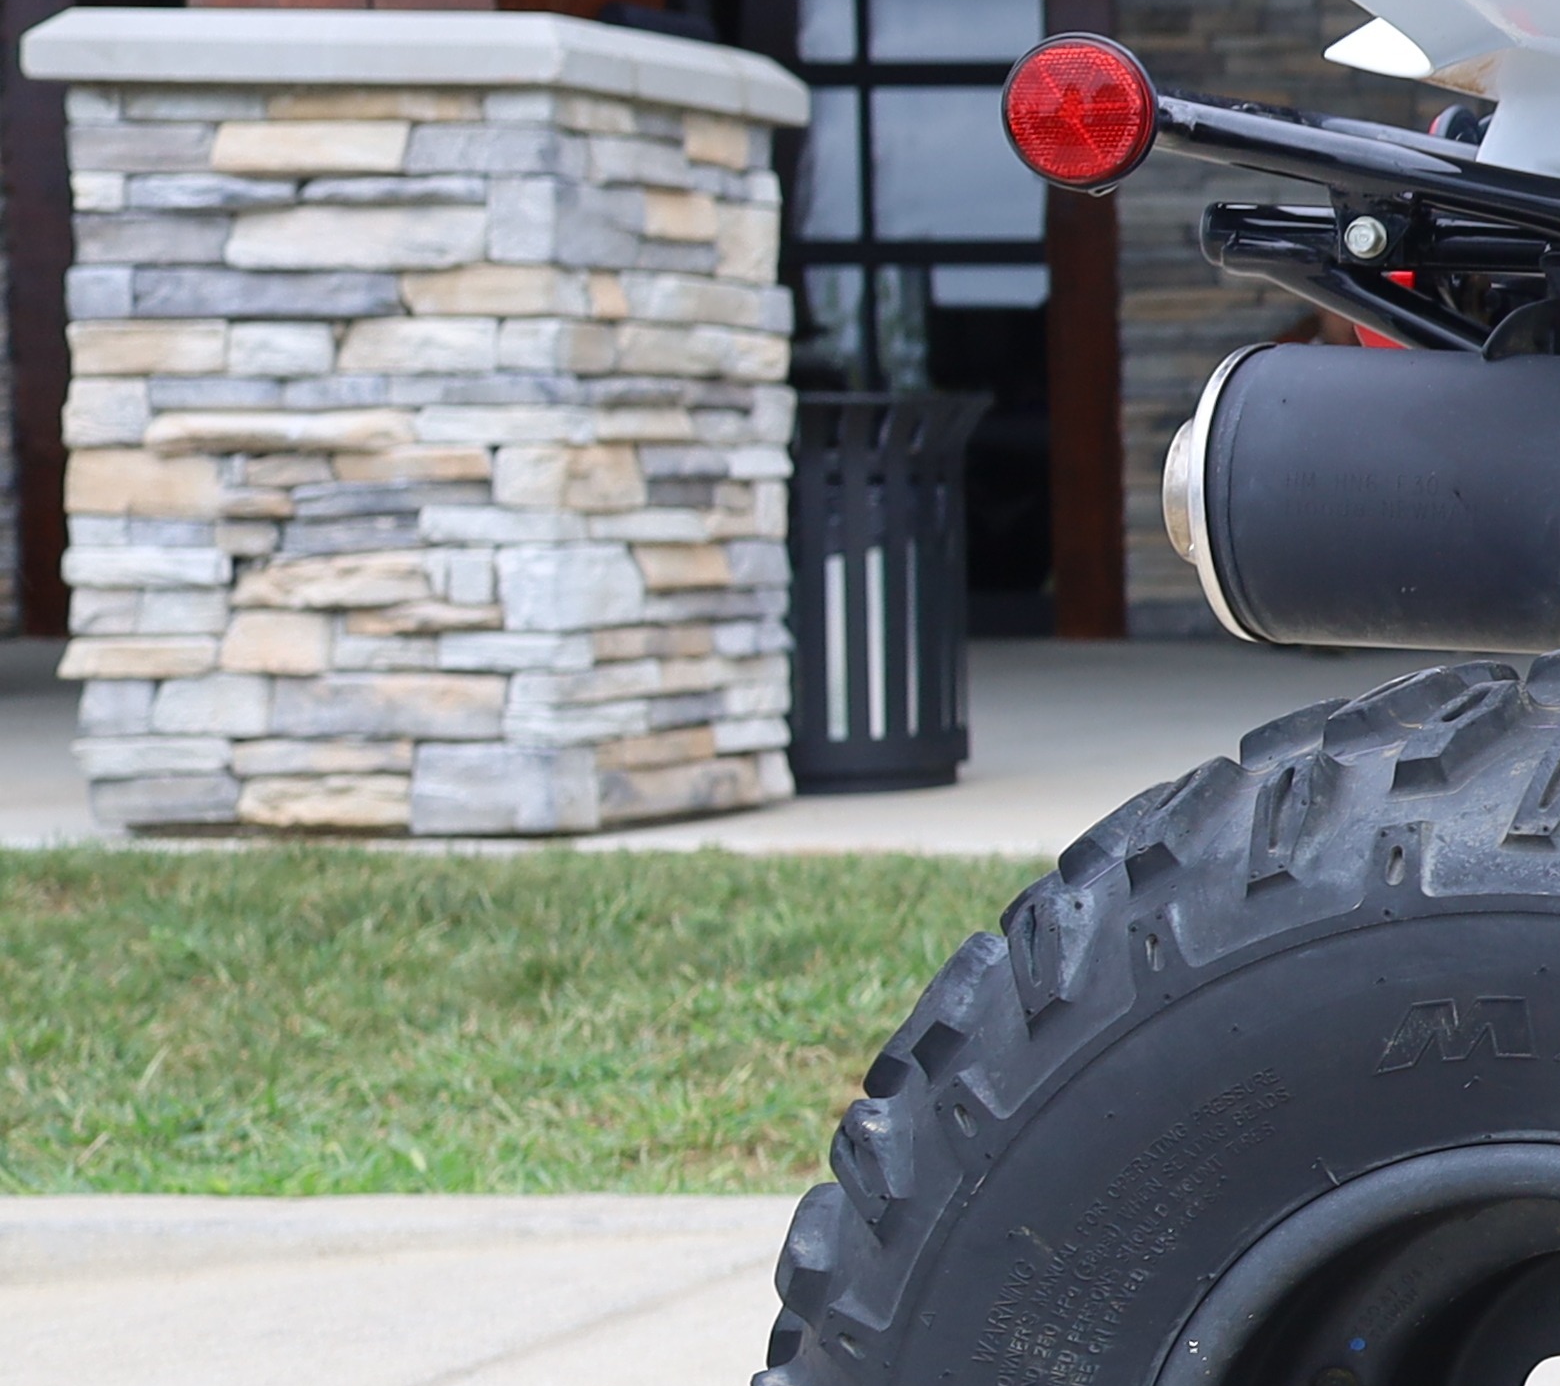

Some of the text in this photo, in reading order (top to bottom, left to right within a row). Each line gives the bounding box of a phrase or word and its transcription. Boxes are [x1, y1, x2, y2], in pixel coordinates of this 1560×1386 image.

[1028, 1237, 1081, 1308] MANUAL
[1104, 1118, 1192, 1202] OPERATING
[1063, 1264, 1122, 1345] PERSONS
[1113, 1198, 1173, 1266] SHOULD
[1167, 1150, 1225, 1205] MOUNT
[1115, 1173, 1165, 1224] WHEN
[970, 1254, 1038, 1367] WARNING
